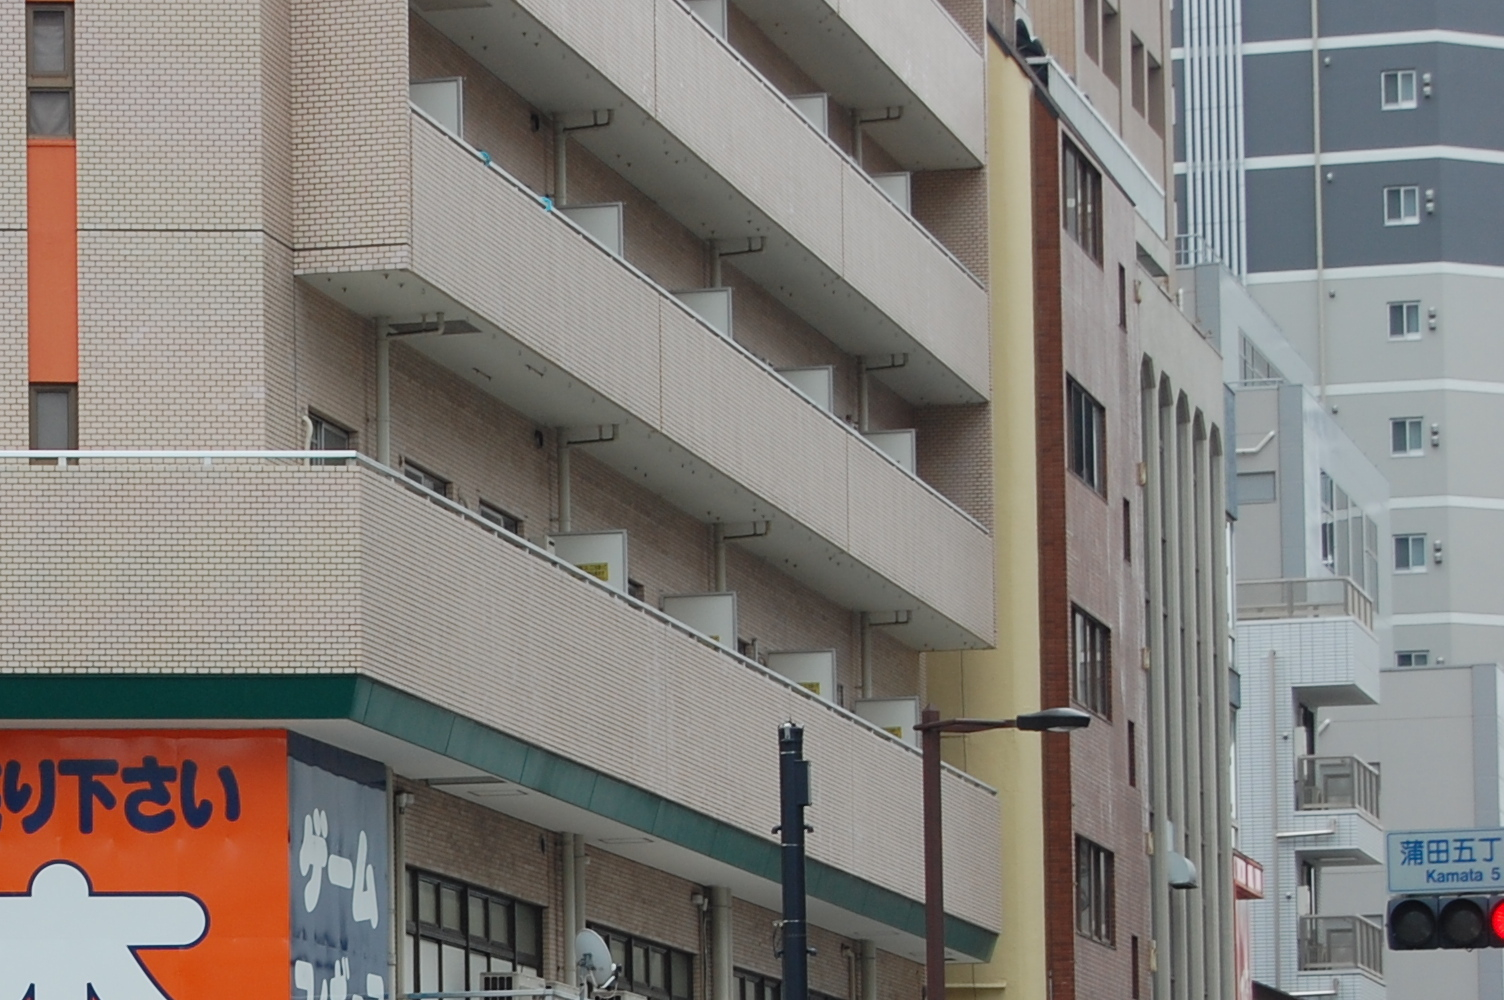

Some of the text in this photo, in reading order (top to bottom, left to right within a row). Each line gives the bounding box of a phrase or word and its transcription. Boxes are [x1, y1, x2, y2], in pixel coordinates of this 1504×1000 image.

[299, 808, 379, 930] ゲーム
[1425, 866, 1501, 883] Kamata 5
